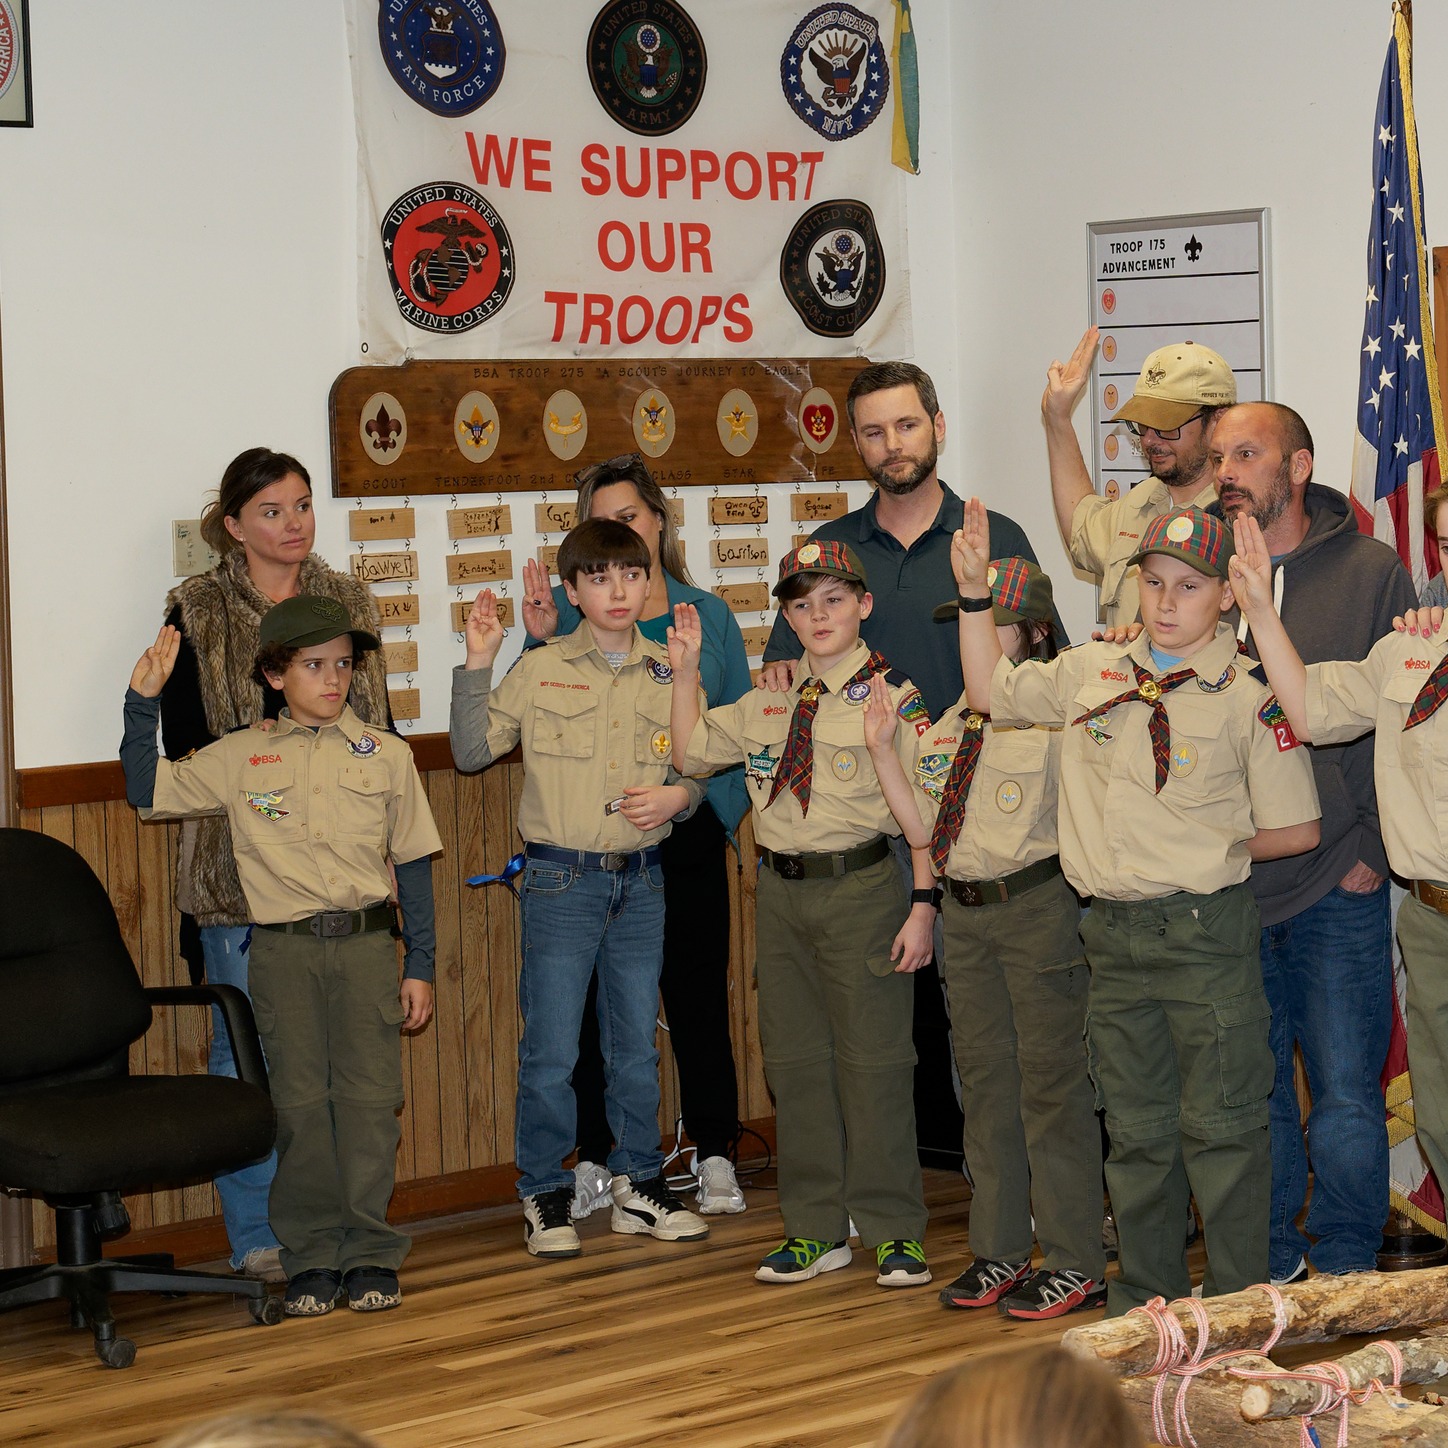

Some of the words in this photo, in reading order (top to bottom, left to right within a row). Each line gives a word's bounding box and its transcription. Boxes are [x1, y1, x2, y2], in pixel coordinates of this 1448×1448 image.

[602, 2, 648, 37] UNITED
[653, 3, 693, 44] STATES
[795, 11, 839, 48] UNITED
[0, 27, 11, 79] MERICA
[402, 65, 426, 95] AIR
[433, 75, 485, 104] FORCE
[627, 108, 671, 124] ARMY
[822, 116, 854, 135] NAVY
[465, 132, 552, 192] WE
[580, 143, 824, 200] SUPPORT
[390, 187, 446, 226] UNITED
[453, 188, 499, 228] STATES
[597, 221, 714, 273] OUR
[1110, 240, 1143, 254] TROOP
[1149, 239, 1166, 250] 175
[1102, 257, 1176, 274] ADVANCEMENT
[395, 288, 449, 329] MARINE
[453, 290, 503, 328] CORPS
[544, 290, 754, 345] TROOPS
[474, 367, 499, 379] BSA
[509, 367, 550, 379] TROOP
[560, 367, 584, 378] 275
[676, 366, 733, 376] JOURNEY
[741, 366, 756, 376] TO
[652, 470, 692, 481] CLASS
[723, 468, 755, 479] STAR
[807, 466, 836, 476] LIFE
[362, 477, 407, 490] SCOUT
[434, 474, 521, 487] TENDERFOOT
[1414, 660, 1431, 670] BSA
[1109, 671, 1128, 683] BSA
[772, 706, 788, 715] BSA
[261, 755, 283, 764] BSA
